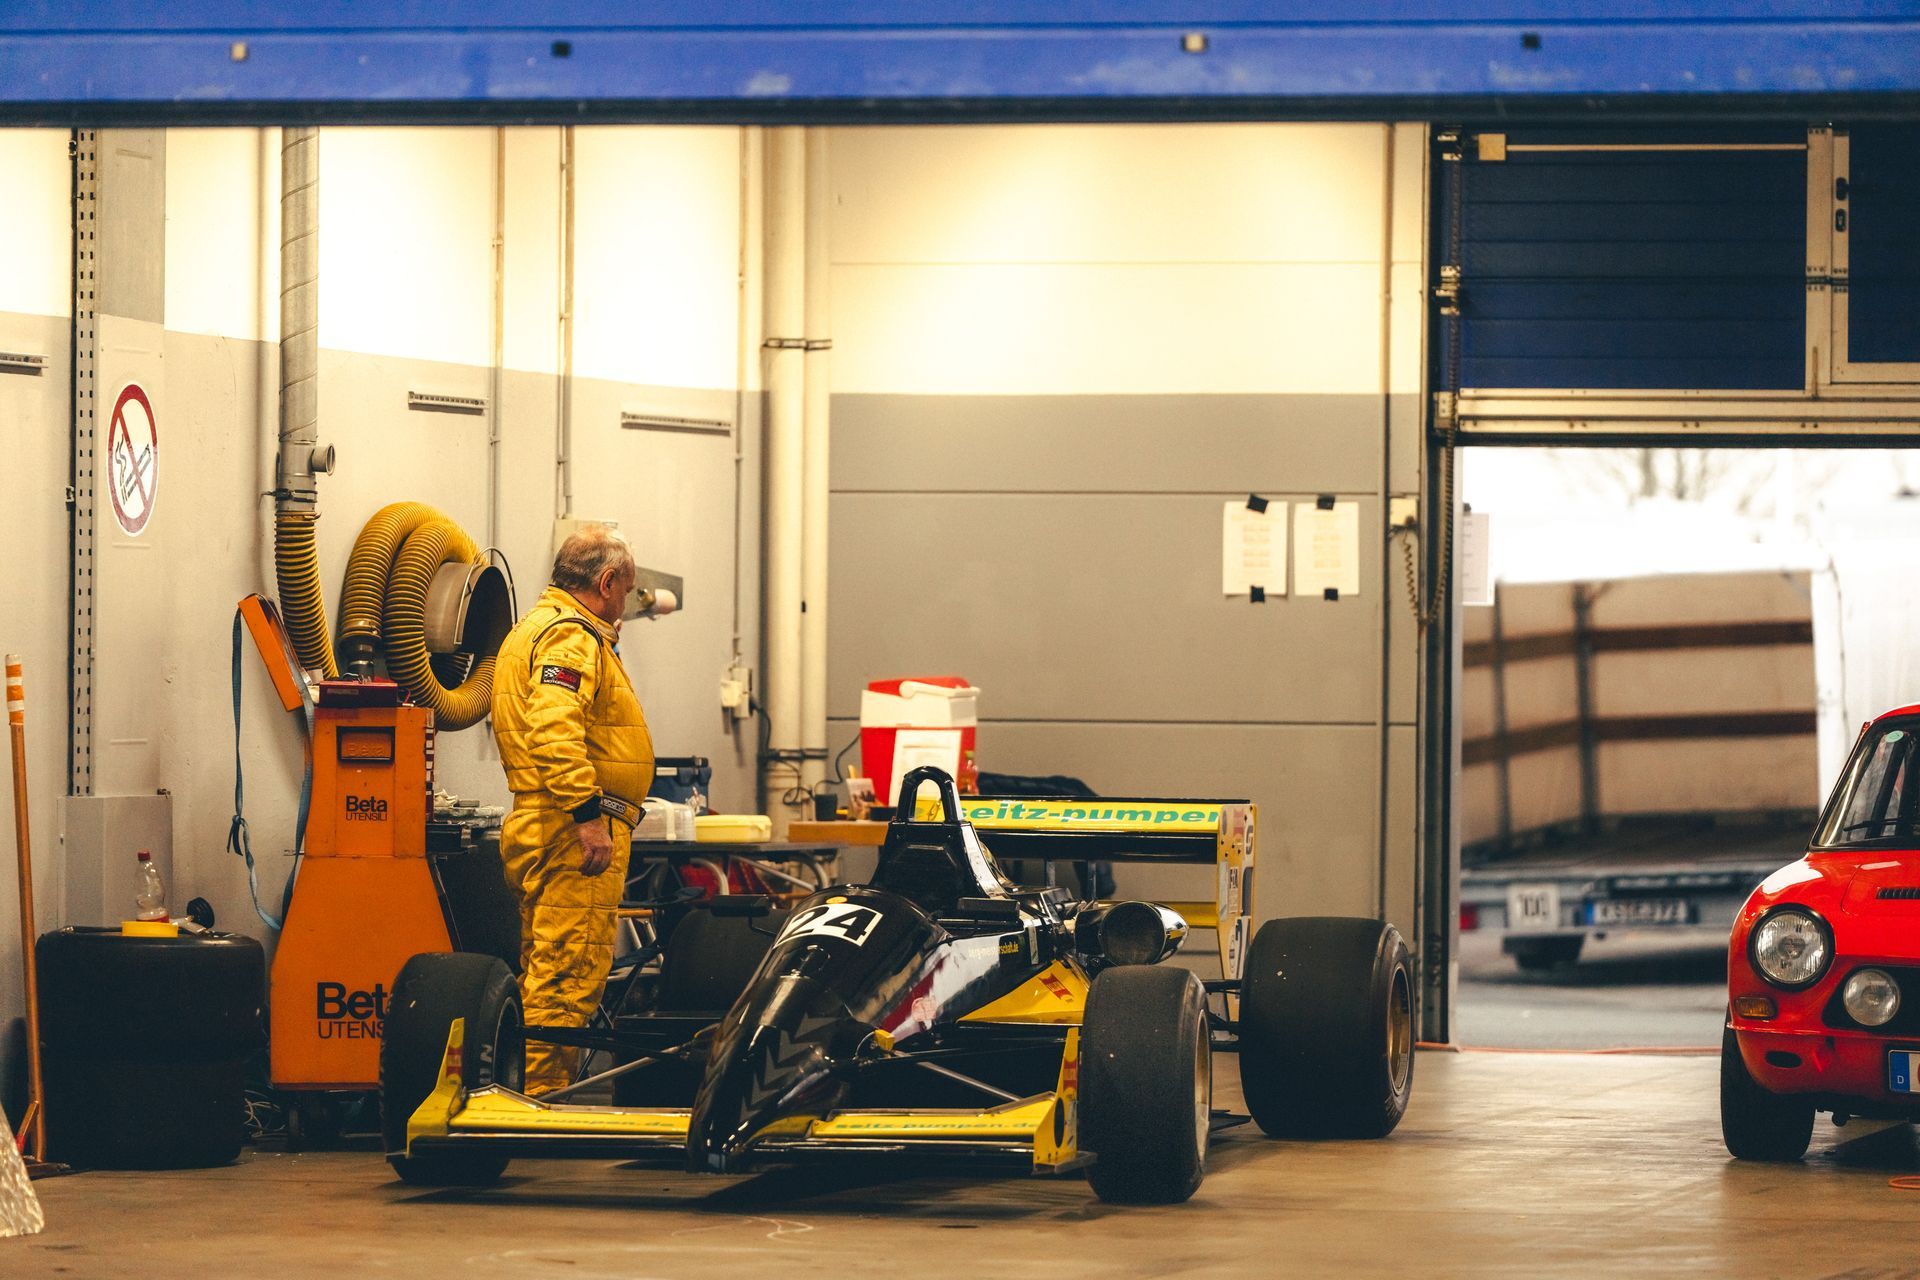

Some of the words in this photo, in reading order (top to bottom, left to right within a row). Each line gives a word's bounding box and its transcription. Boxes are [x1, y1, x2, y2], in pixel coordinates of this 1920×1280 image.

[345, 795, 388, 812] Beta
[345, 813, 388, 821] UTENSILI
[776, 906, 877, 942] 24
[317, 982, 388, 1020] Bet
[317, 1021, 385, 1039] UTENS
[1896, 1075, 1905, 1085] D
